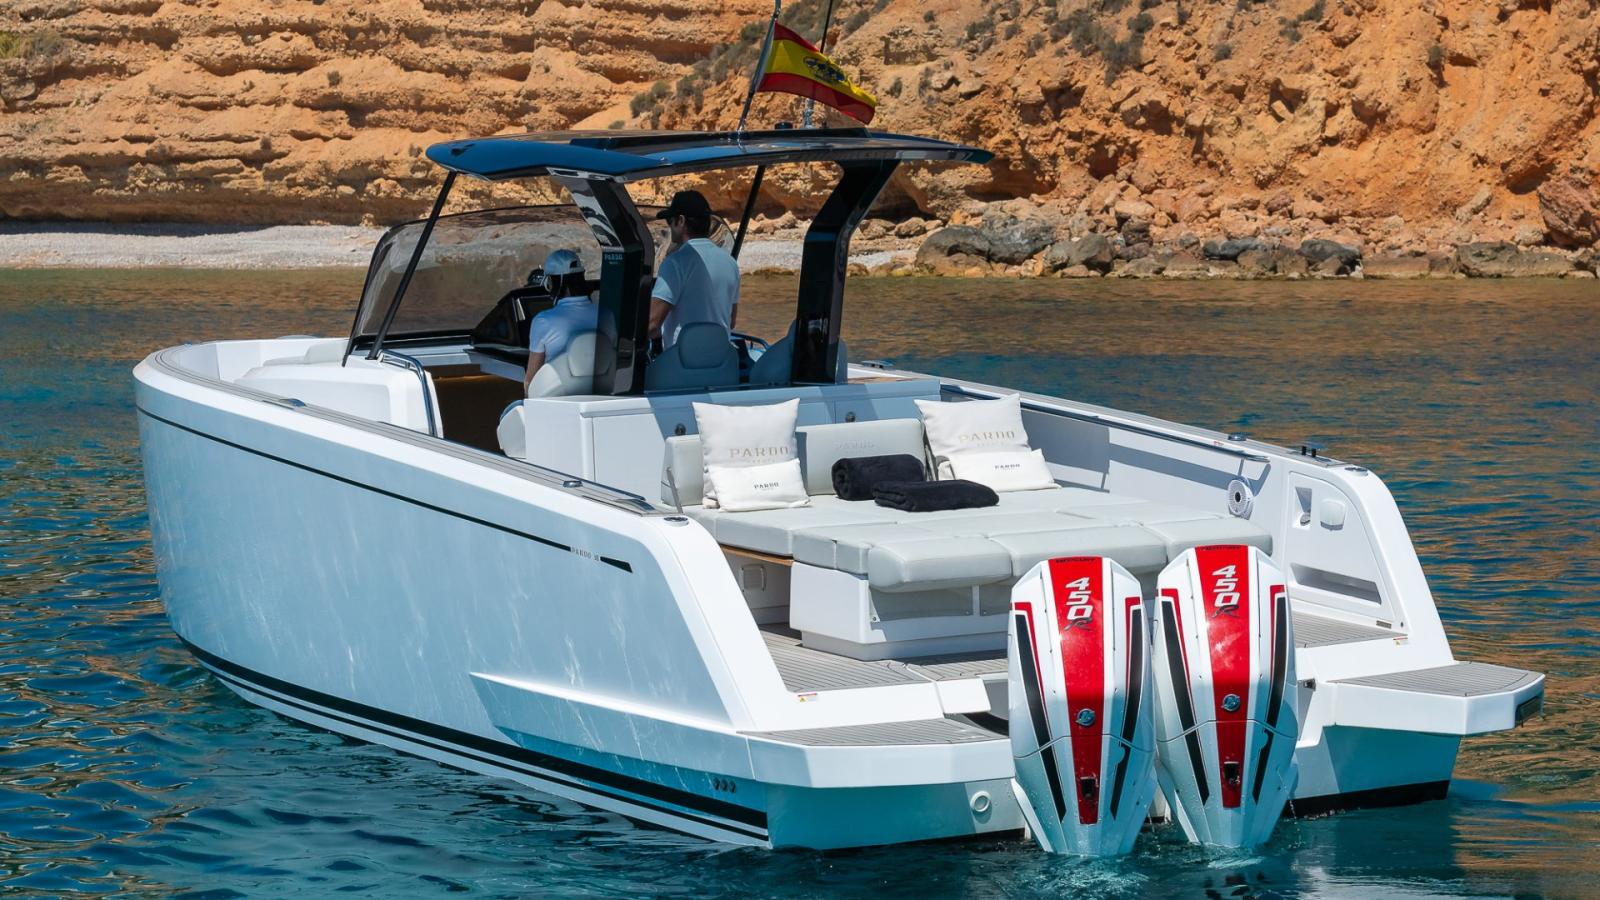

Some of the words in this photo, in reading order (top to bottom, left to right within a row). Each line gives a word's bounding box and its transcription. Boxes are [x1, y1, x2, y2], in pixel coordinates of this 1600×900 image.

[958, 430, 1015, 442] PARDO
[729, 446, 789, 459] PARDO
[1065, 577, 1094, 620] 450
[1211, 564, 1240, 607] 450
